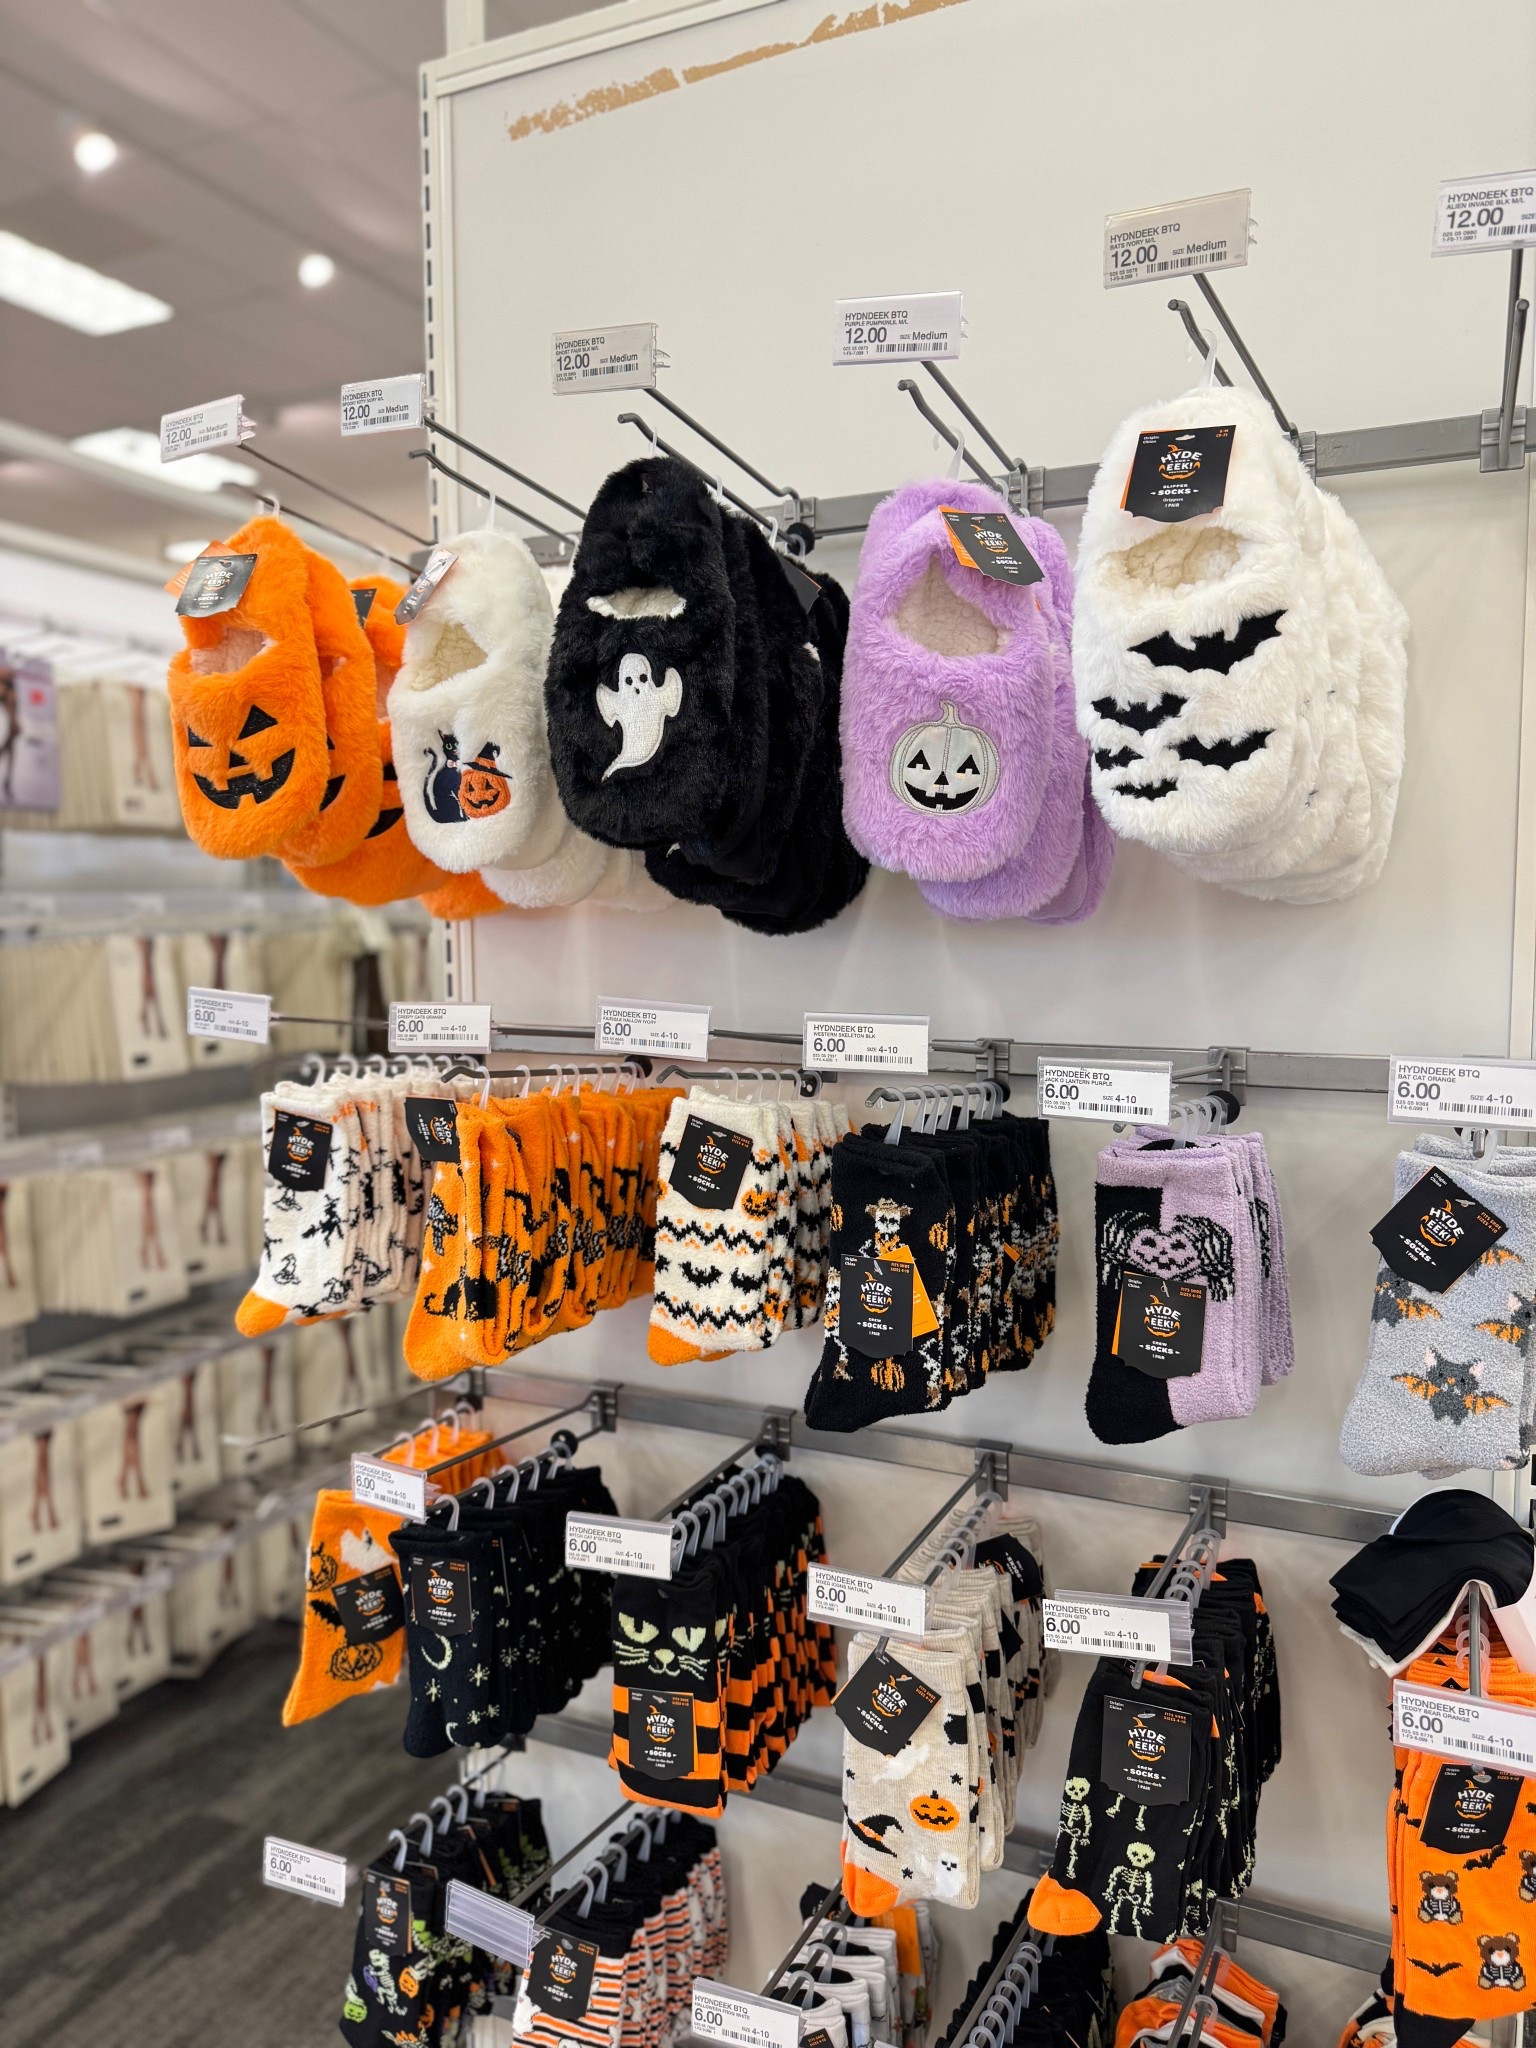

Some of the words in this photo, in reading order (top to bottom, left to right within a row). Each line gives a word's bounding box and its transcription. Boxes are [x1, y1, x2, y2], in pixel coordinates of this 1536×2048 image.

[1448, 189, 1508, 203] HYDNDEEK
[1510, 187, 1534, 197] BTQ
[1447, 207, 1504, 229] 12.00
[1110, 226, 1159, 243] HYDNDEEK
[1161, 223, 1181, 234] BTQ
[1110, 242, 1125, 250] BATS
[1126, 239, 1144, 247] IVORY
[1111, 244, 1158, 268] 12.00
[1186, 240, 1227, 255] Medium
[845, 311, 889, 321] HYDNDEEK
[891, 310, 908, 319] BTQ
[555, 338, 590, 350] HYDNDEEK
[591, 336, 605, 345] BTQ
[845, 327, 887, 344] 12.00
[912, 331, 948, 341] Medium
[556, 353, 590, 371] 12.00
[610, 353, 638, 364] Medium
[343, 392, 371, 402] HYDNDEEK
[371, 389, 383, 397] BTQ
[343, 404, 371, 421] 12.00
[386, 405, 409, 414] Medium
[166, 428, 192, 445] 12.00
[206, 423, 228, 433] Medium
[1160, 451, 1203, 463] HYDE
[1166, 462, 1193, 472] EEK!
[1157, 488, 1191, 496] SOCKS
[974, 531, 1002, 540] HYDE
[194, 1009, 216, 1023] 6.00
[603, 1009, 641, 1019] HYDNDEEK
[397, 1020, 424, 1033] 6.00
[603, 1022, 631, 1037] 6.00
[660, 1031, 678, 1040] 4-10
[813, 1024, 856, 1033] HYDNDEEK
[857, 1026, 874, 1034] BTQ
[813, 1037, 845, 1052] 6.00
[878, 1045, 898, 1054] 4-10
[1045, 1069, 1090, 1080] HYDNDEEK
[1092, 1072, 1110, 1081] BTQ
[1398, 1064, 1456, 1077] HYDNDEEK
[1458, 1069, 1481, 1079] BTQ
[1045, 1083, 1079, 1100] 6.00
[1115, 1094, 1137, 1104] 4-10
[1397, 1081, 1441, 1100] 6.00
[1469, 1094, 1485, 1102] SIZE
[1486, 1093, 1513, 1104] 4-10
[439, 1117, 453, 1145] HYDE
[288, 1135, 315, 1149] HYDE
[291, 1144, 308, 1155] EEK!
[700, 1144, 729, 1162] HYDE
[702, 1155, 721, 1168] EEK!
[692, 1176, 716, 1189] SOCKS
[1426, 1219, 1452, 1241] EEK!
[1429, 1207, 1465, 1238] HYDE
[1403, 1238, 1432, 1262] SOCKS
[1414, 1239, 1430, 1252] CREW
[861, 1282, 893, 1296] HYDE
[866, 1295, 887, 1305] EEK!
[1144, 1305, 1181, 1320] HYDE
[862, 1321, 888, 1330] SOCKS
[1150, 1318, 1174, 1329] EEK!
[1144, 1344, 1174, 1354] SOCKS
[356, 1475, 375, 1491] 6.00
[394, 1490, 407, 1500] 4-10
[569, 1525, 606, 1537] HYDNDEEK
[607, 1531, 622, 1539] BTQ
[569, 1538, 597, 1554] 6.00
[625, 1551, 643, 1560] 4-10
[427, 1578, 454, 1590] HYDE
[815, 1571, 856, 1587] HYDNDEEK
[857, 1580, 873, 1590] BTQ
[847, 1585, 870, 1595] NATURAL
[815, 1585, 846, 1604] 6.00
[877, 1602, 897, 1614] 4-10
[1044, 1602, 1091, 1615] HYDNDEEK
[1092, 1608, 1110, 1617] BTQ
[1044, 1611, 1073, 1619] SKELETON
[1045, 1617, 1080, 1635] 6.00
[1116, 1630, 1139, 1640] 4-10
[877, 1693, 897, 1712] EEK!
[878, 1682, 908, 1709] HYDE
[1401, 1696, 1456, 1714] HYDNDEEK
[1458, 1707, 1480, 1719] BTQ
[1401, 1705, 1422, 1713] TEDDY
[1423, 1709, 1441, 1717] BEAR
[1442, 1712, 1471, 1723] ORANGE
[646, 1714, 675, 1728] HYDE
[860, 1710, 884, 1731] SOCKS
[651, 1726, 670, 1735] EEK!
[1128, 1728, 1166, 1744] HYDE
[1401, 1712, 1443, 1734] 6.00
[1471, 1733, 1486, 1741] SIZE
[1486, 1735, 1513, 1748] 4-10
[649, 1749, 672, 1758] SOCKS
[1134, 1741, 1159, 1753] EEK!
[1129, 1768, 1160, 1780] SOCKS
[1457, 1789, 1495, 1803] HYDE
[1461, 1801, 1486, 1811] EEK!
[270, 1845, 299, 1859] HYDNDEEK
[299, 1855, 311, 1863] BTQ
[270, 1857, 292, 1874] 6.00
[312, 1875, 326, 1884] 4-10
[551, 1955, 578, 1970] HYDE
[554, 1965, 572, 1977] EEK!
[547, 1987, 569, 1999] SOCKS
[694, 1994, 733, 2010] HYDNDEEK
[733, 2004, 748, 2014] BTQ
[694, 2007, 723, 2026] 6.00
[752, 2028, 770, 2039] 4-10
